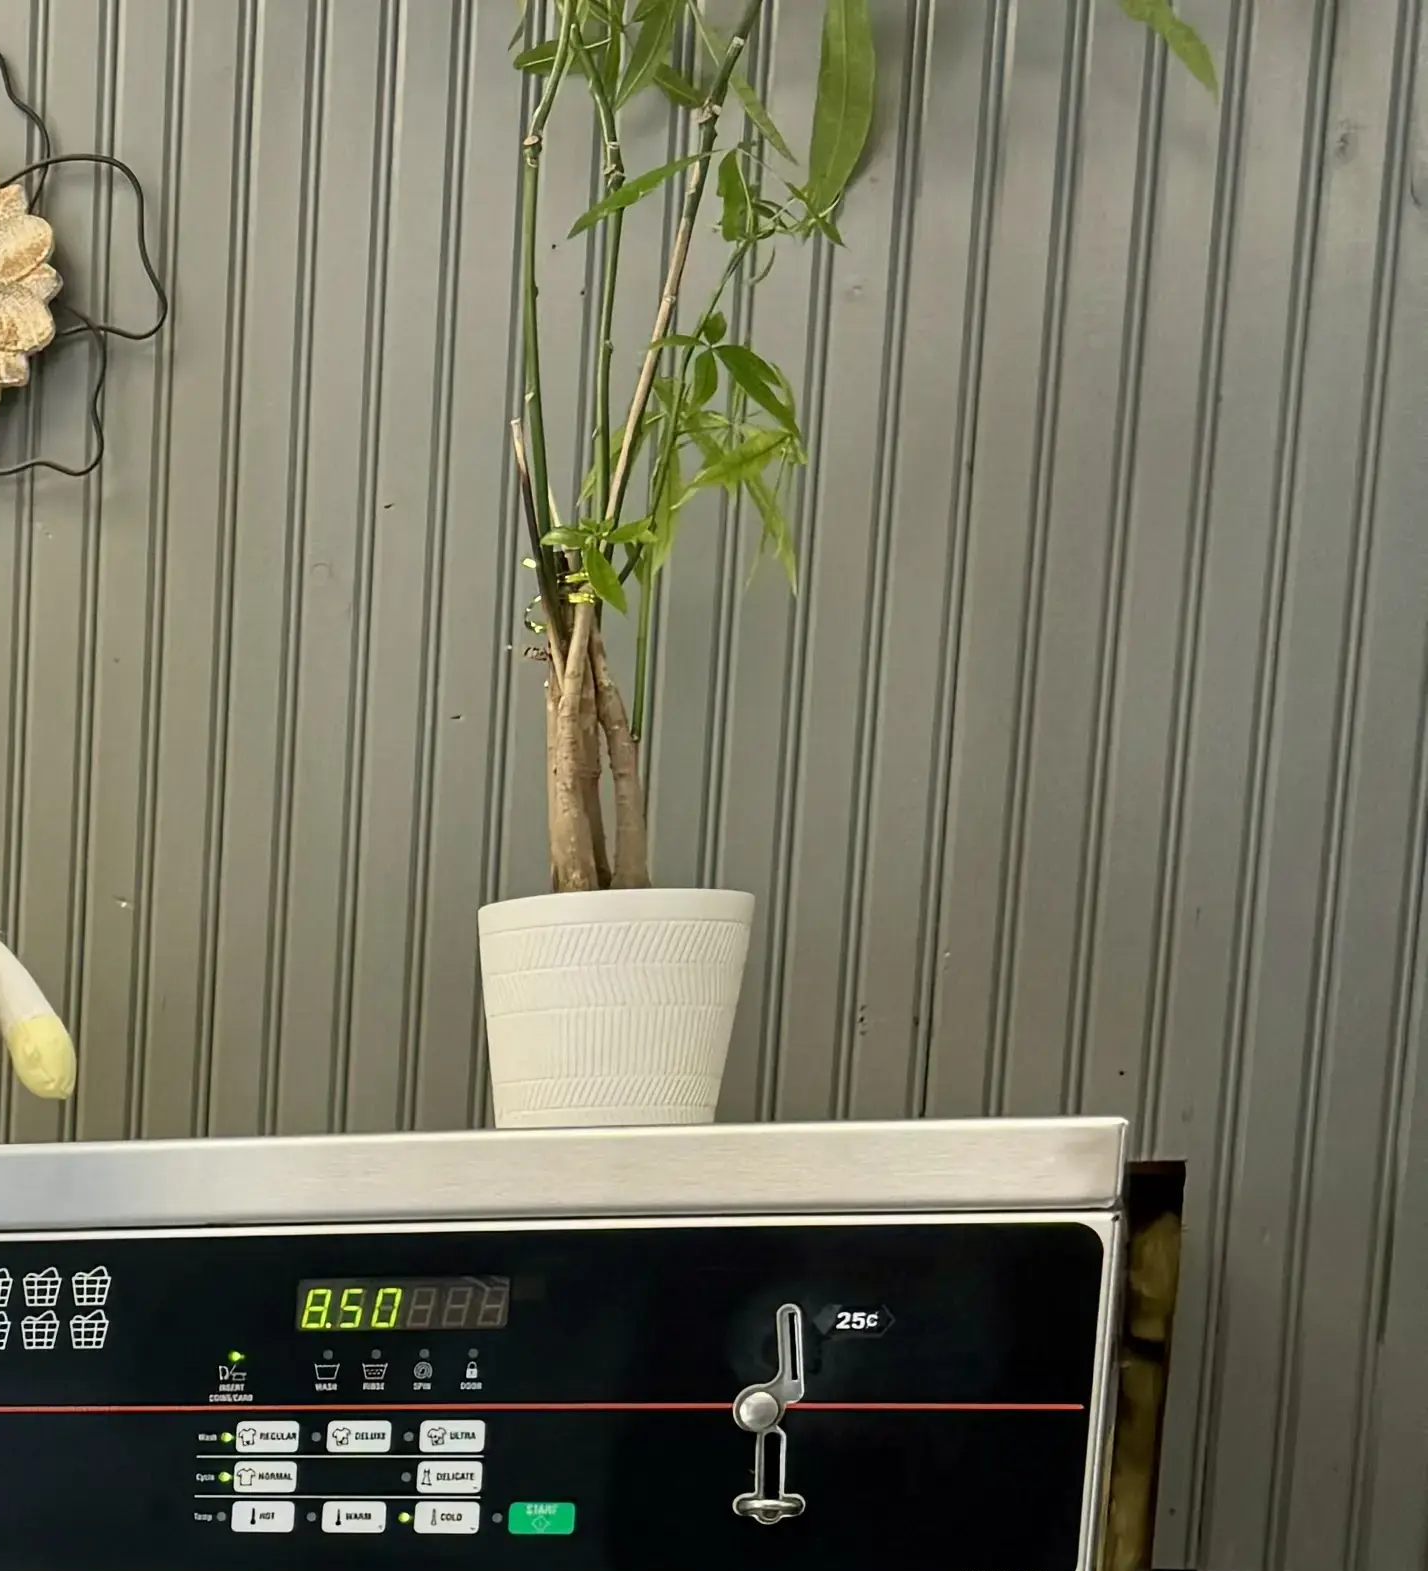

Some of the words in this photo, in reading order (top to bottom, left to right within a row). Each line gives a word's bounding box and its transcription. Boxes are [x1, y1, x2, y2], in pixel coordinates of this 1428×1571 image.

[301, 1287, 402, 1328] 8.50
[835, 1311, 879, 1330] 25¢
[259, 1432, 297, 1441] REGULAR
[354, 1432, 386, 1441] DELUXE
[449, 1431, 476, 1440] ULTRA
[258, 1472, 293, 1480] NORMAL
[436, 1472, 475, 1481] DELICATE
[259, 1512, 275, 1520] HOT
[440, 1512, 463, 1521] COLD
